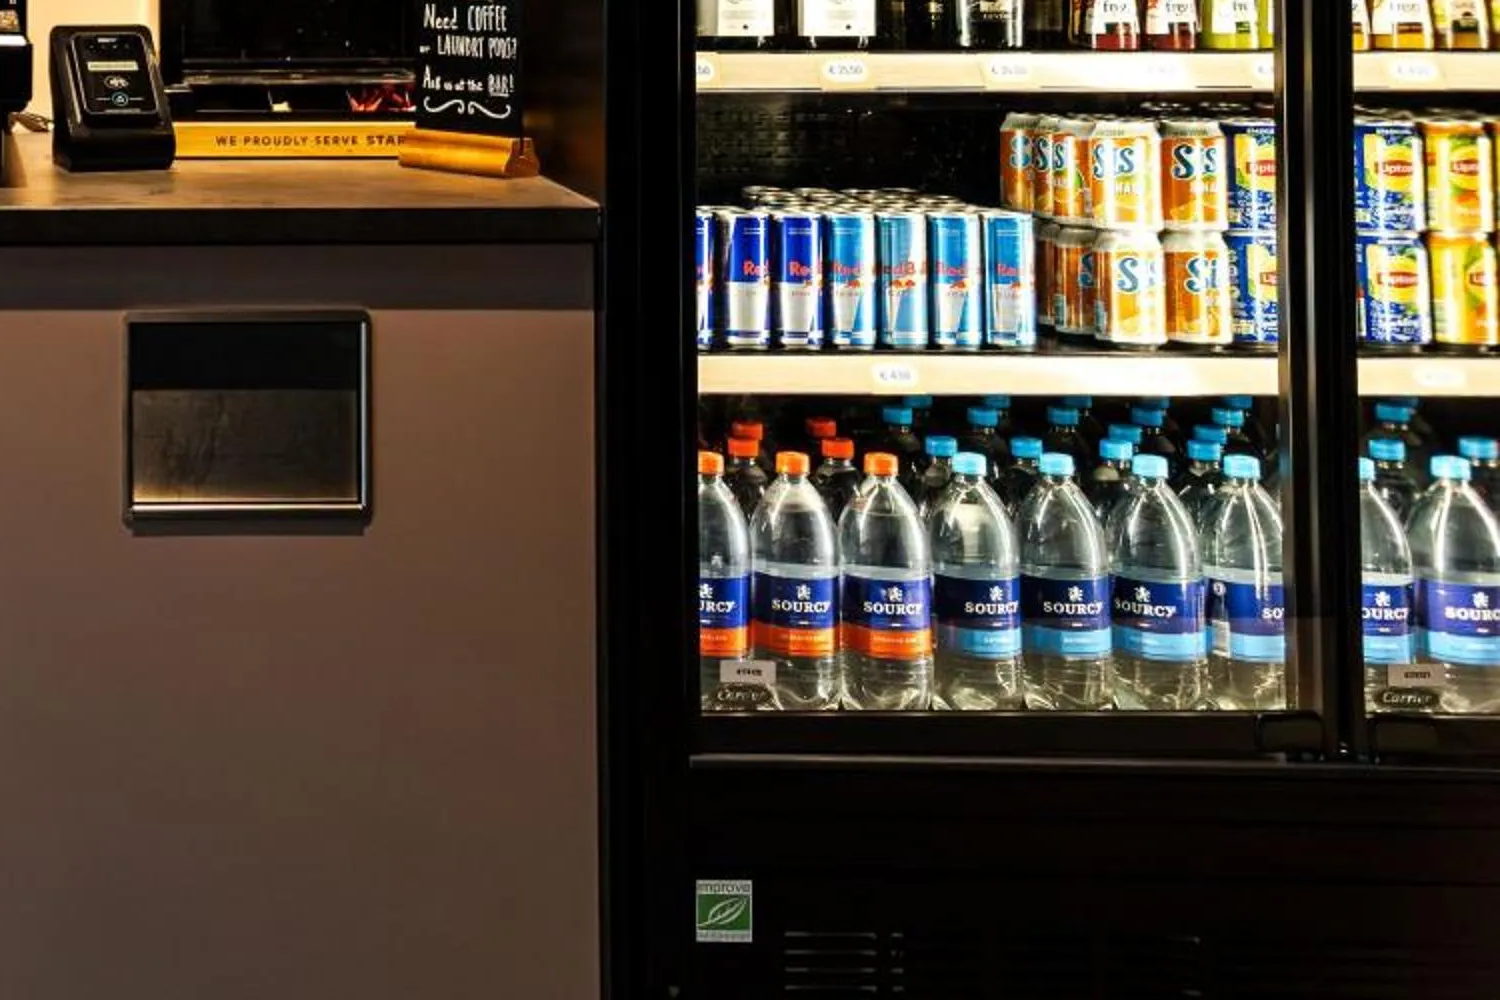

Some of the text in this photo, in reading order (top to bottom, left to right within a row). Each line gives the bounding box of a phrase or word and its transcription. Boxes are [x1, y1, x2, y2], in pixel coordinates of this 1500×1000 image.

[423, 3, 508, 32] Need COFFEE
[437, 34, 483, 60] LAUNDRY
[216, 136, 237, 146] WE
[244, 135, 309, 146] PROUDLY
[315, 136, 358, 146] SERVE
[771, 599, 831, 614] SOURCY
[863, 600, 923, 616] SOURCY
[964, 601, 1018, 615] SOURCY
[1043, 601, 1103, 615] SOURCY
